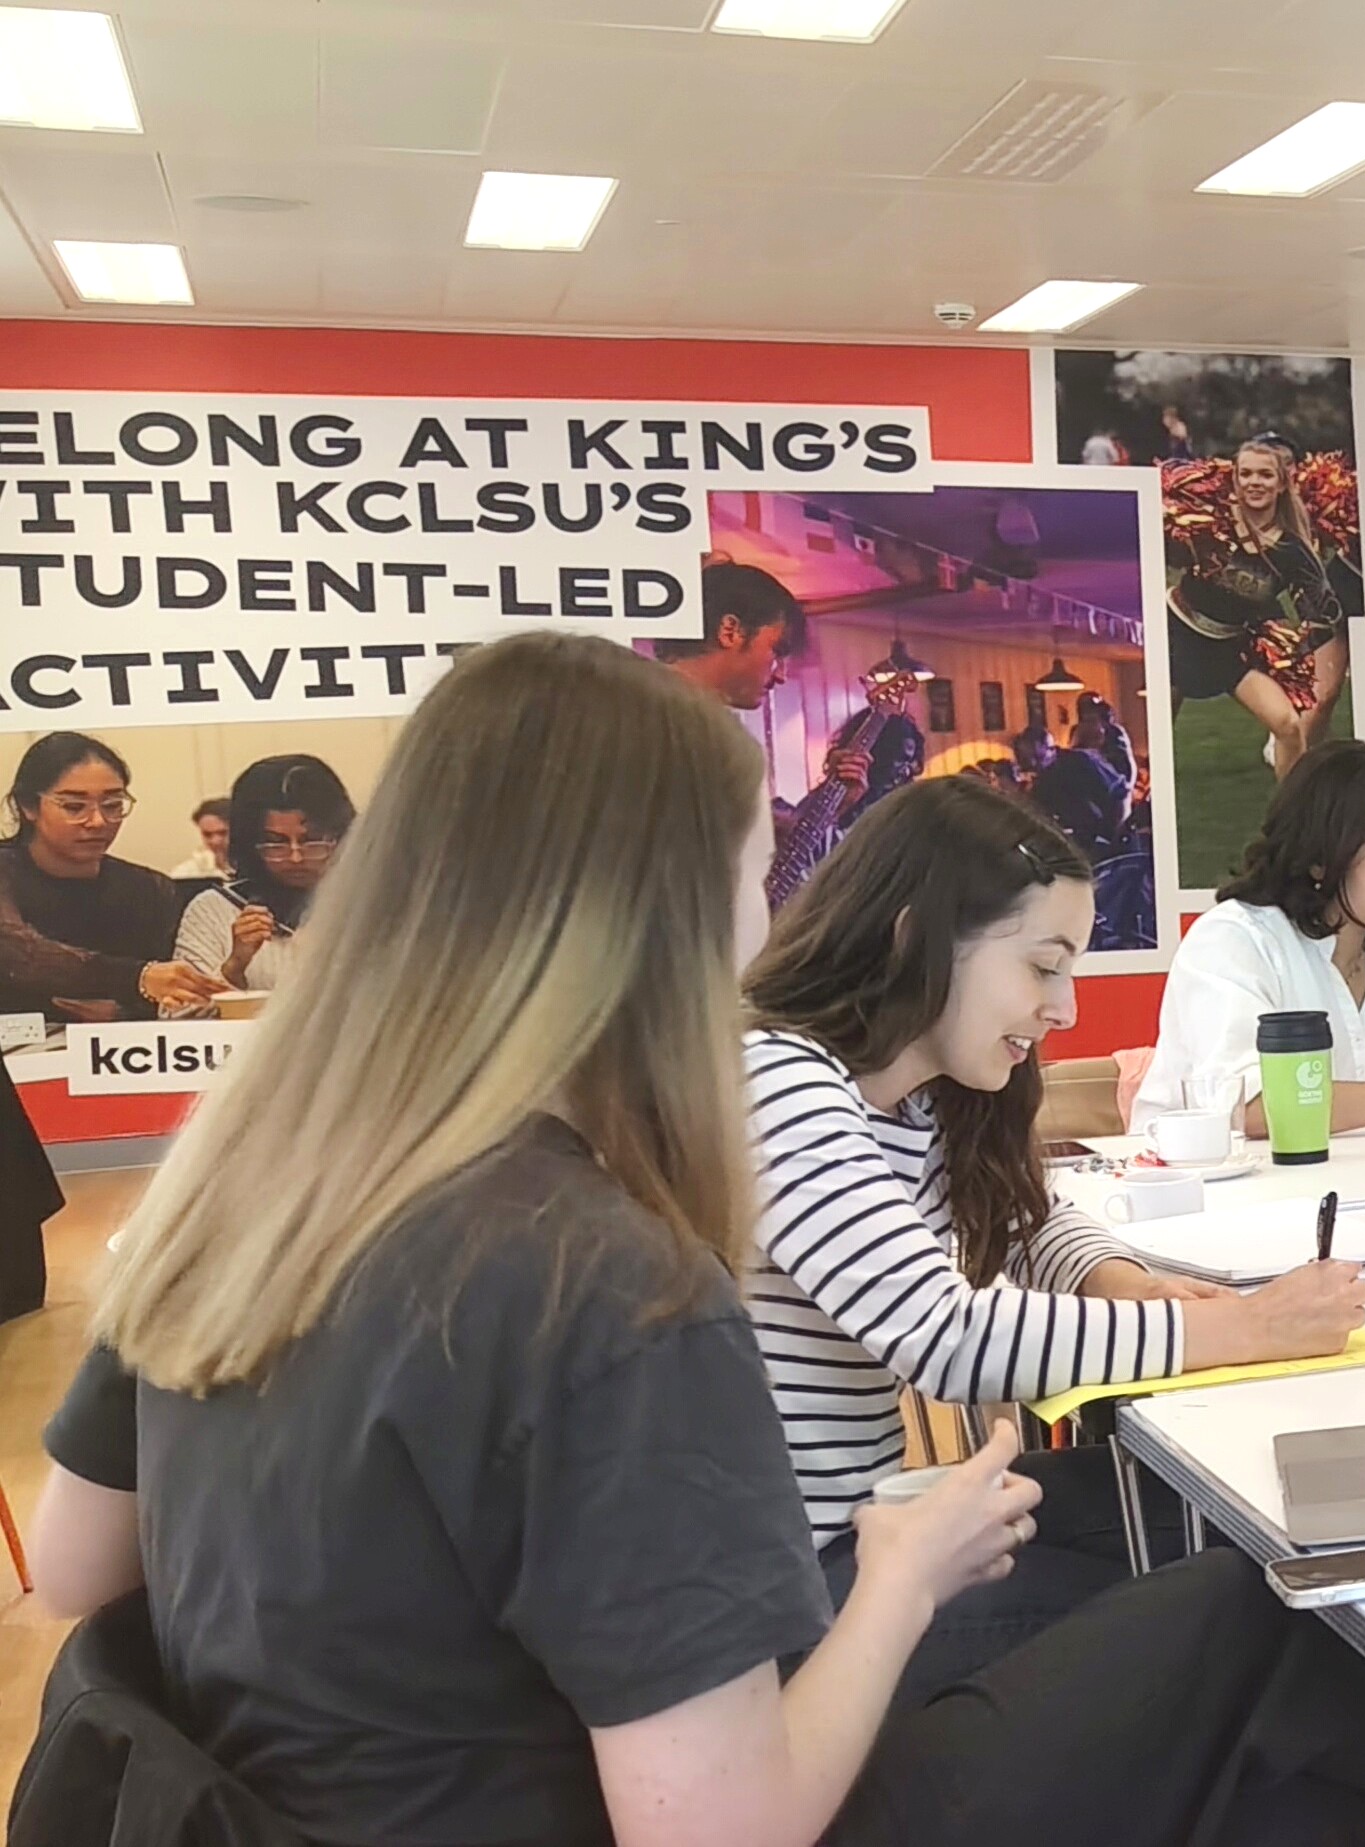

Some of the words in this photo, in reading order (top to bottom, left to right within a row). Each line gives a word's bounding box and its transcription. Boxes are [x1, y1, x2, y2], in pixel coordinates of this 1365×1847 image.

[400, 417, 528, 469] AT
[567, 419, 918, 473] KING'S
[0, 480, 232, 533] ITH
[277, 480, 693, 534] KCLSU'S
[0, 553, 684, 618] TUDENT-LED
[0, 643, 483, 711] CTIVIT
